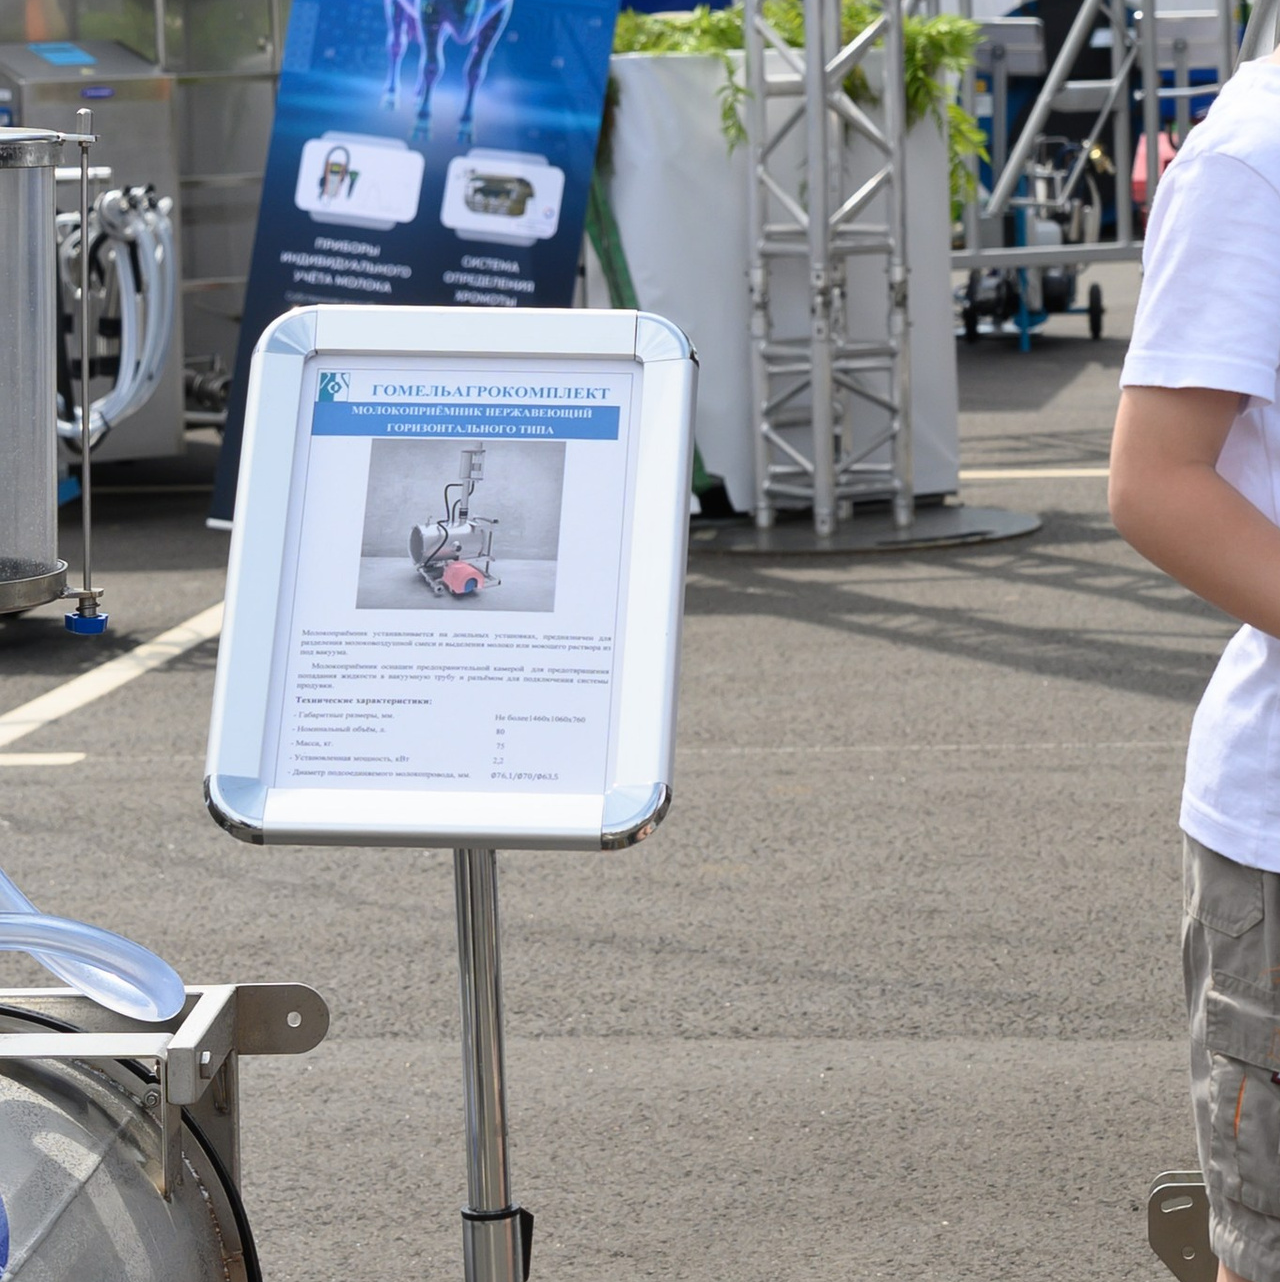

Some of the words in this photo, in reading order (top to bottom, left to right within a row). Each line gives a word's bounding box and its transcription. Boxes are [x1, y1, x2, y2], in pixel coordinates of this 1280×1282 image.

[372, 384, 611, 400] ГОМЕЛЬАГРОКОМПЛЕКТ
[351, 405, 483, 418] МОЛОКОПРИЁМНИК
[485, 406, 593, 420] НЕРЖАВЕЮЩИЙ
[386, 422, 516, 435] ГОРИЗОНТАЛЬНОГО
[518, 425, 555, 436] ТИПА
